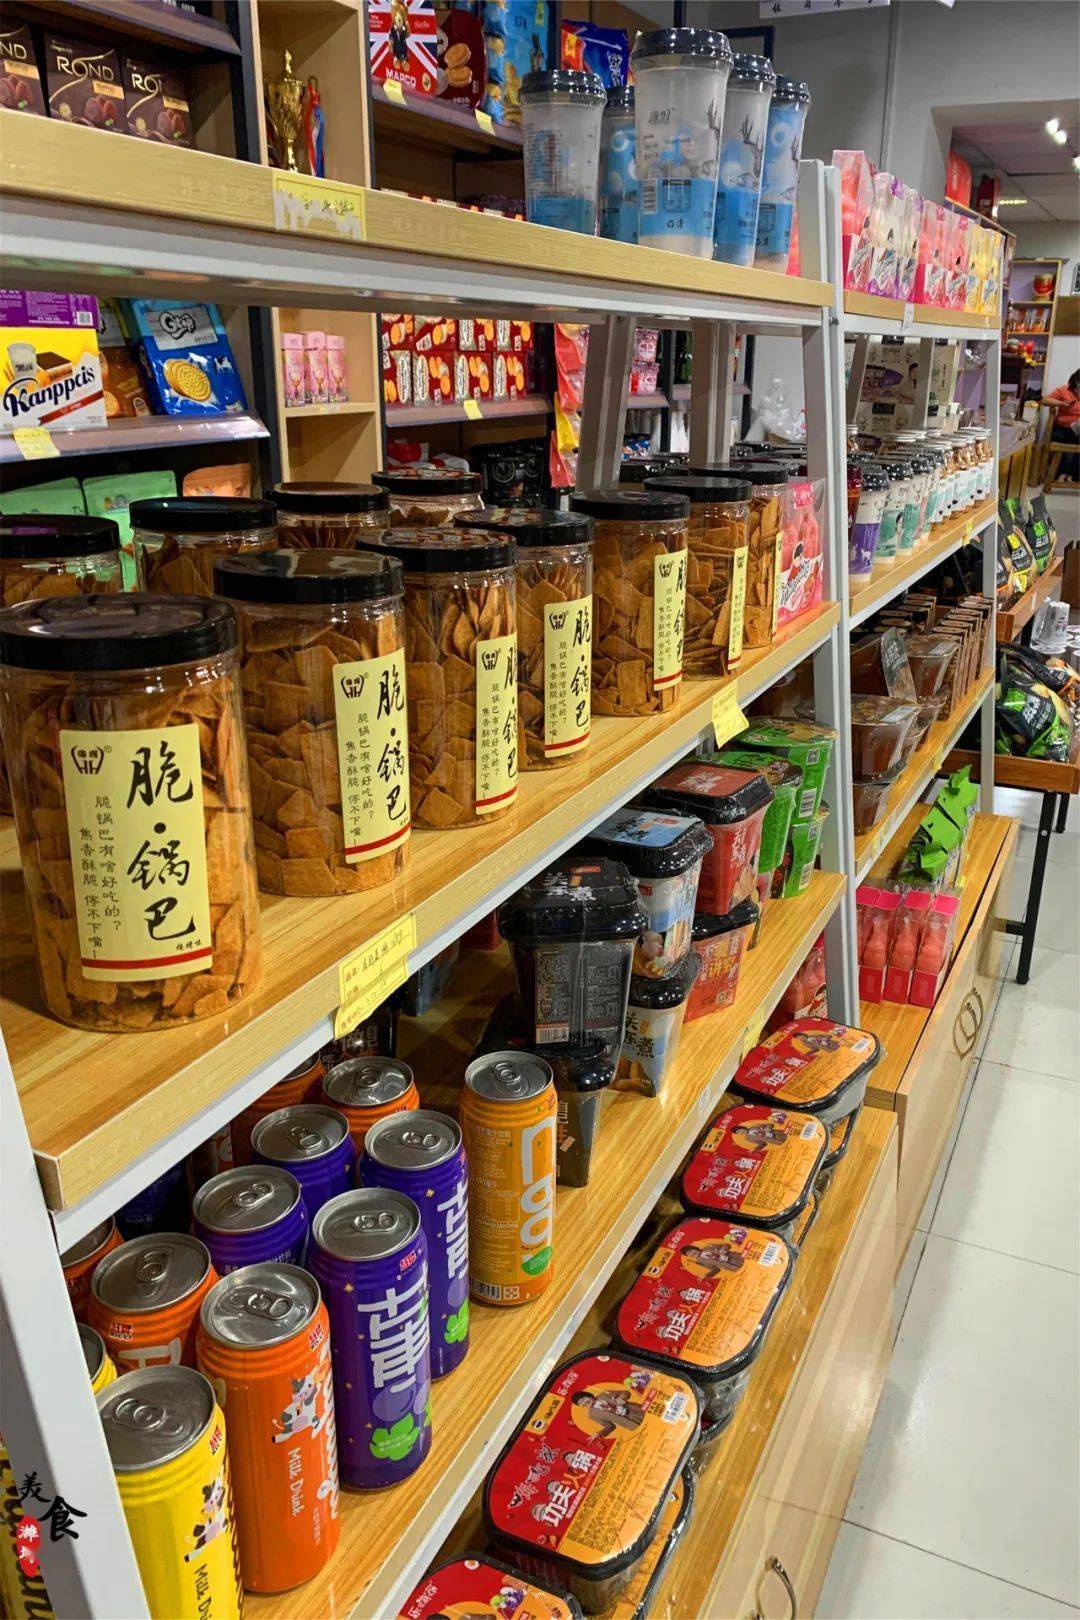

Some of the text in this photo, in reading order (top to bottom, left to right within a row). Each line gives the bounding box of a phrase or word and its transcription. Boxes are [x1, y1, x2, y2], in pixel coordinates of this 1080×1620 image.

[56, 55, 114, 81] ROND
[288, 1446, 305, 1519] Milk Drink
[194, 1563, 211, 1601] Milk
